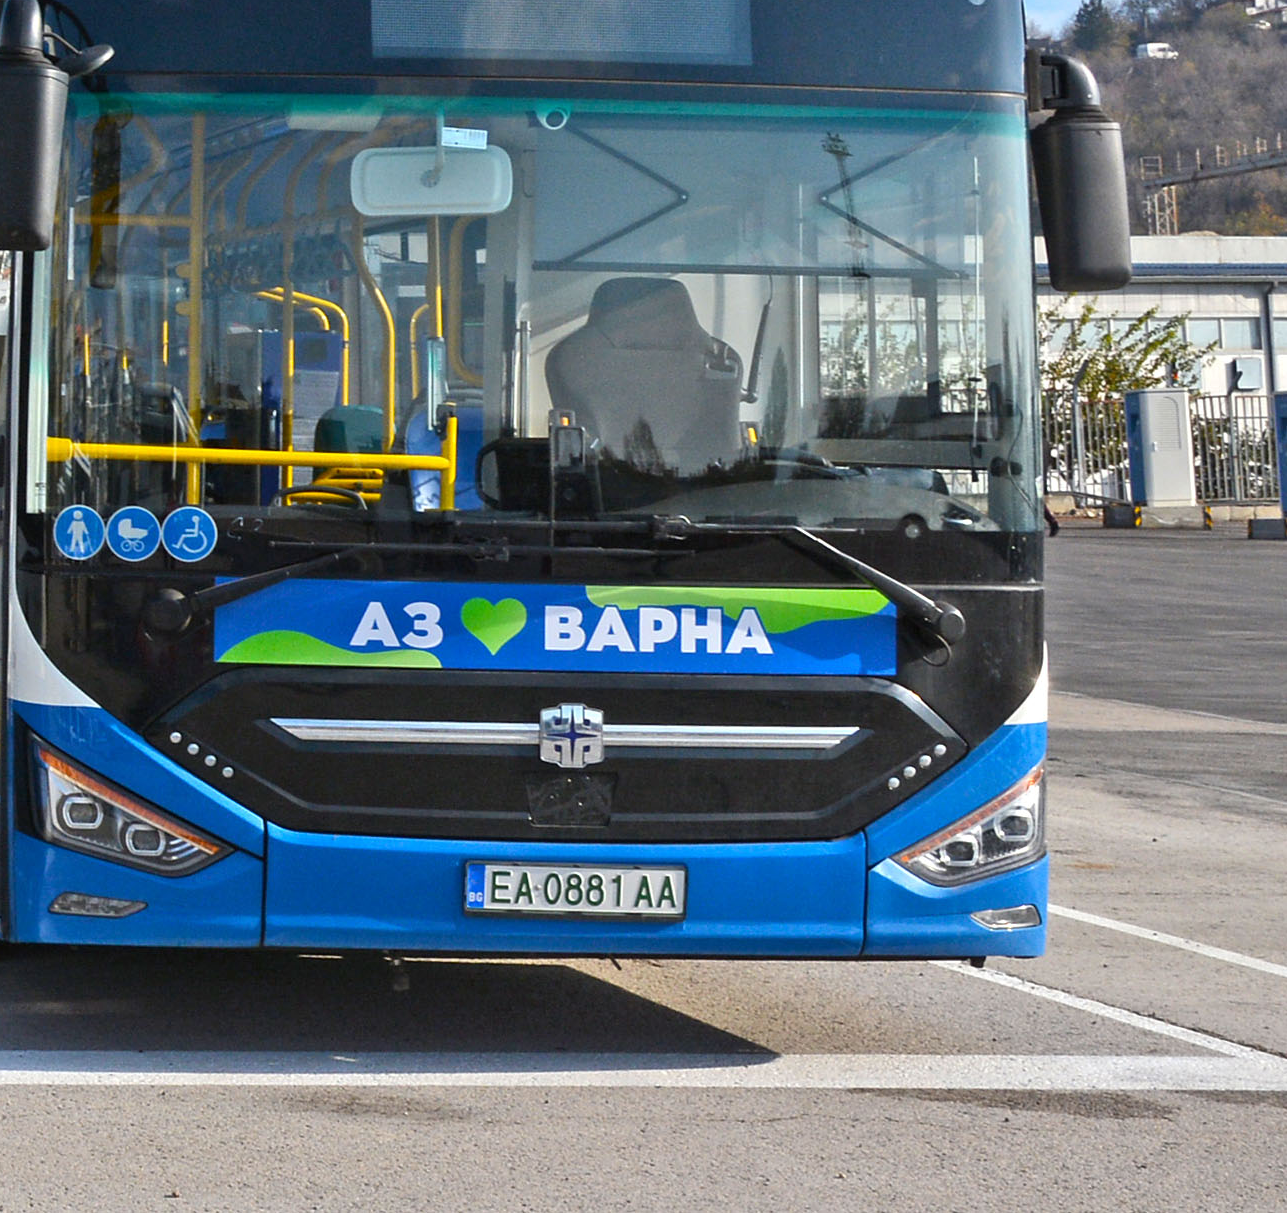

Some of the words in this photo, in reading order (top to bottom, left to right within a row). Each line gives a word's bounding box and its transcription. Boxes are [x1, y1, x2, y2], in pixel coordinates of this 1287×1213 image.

[349, 601, 444, 649] АЗ
[544, 606, 774, 655] ВАРНА
[468, 891, 484, 903] BG
